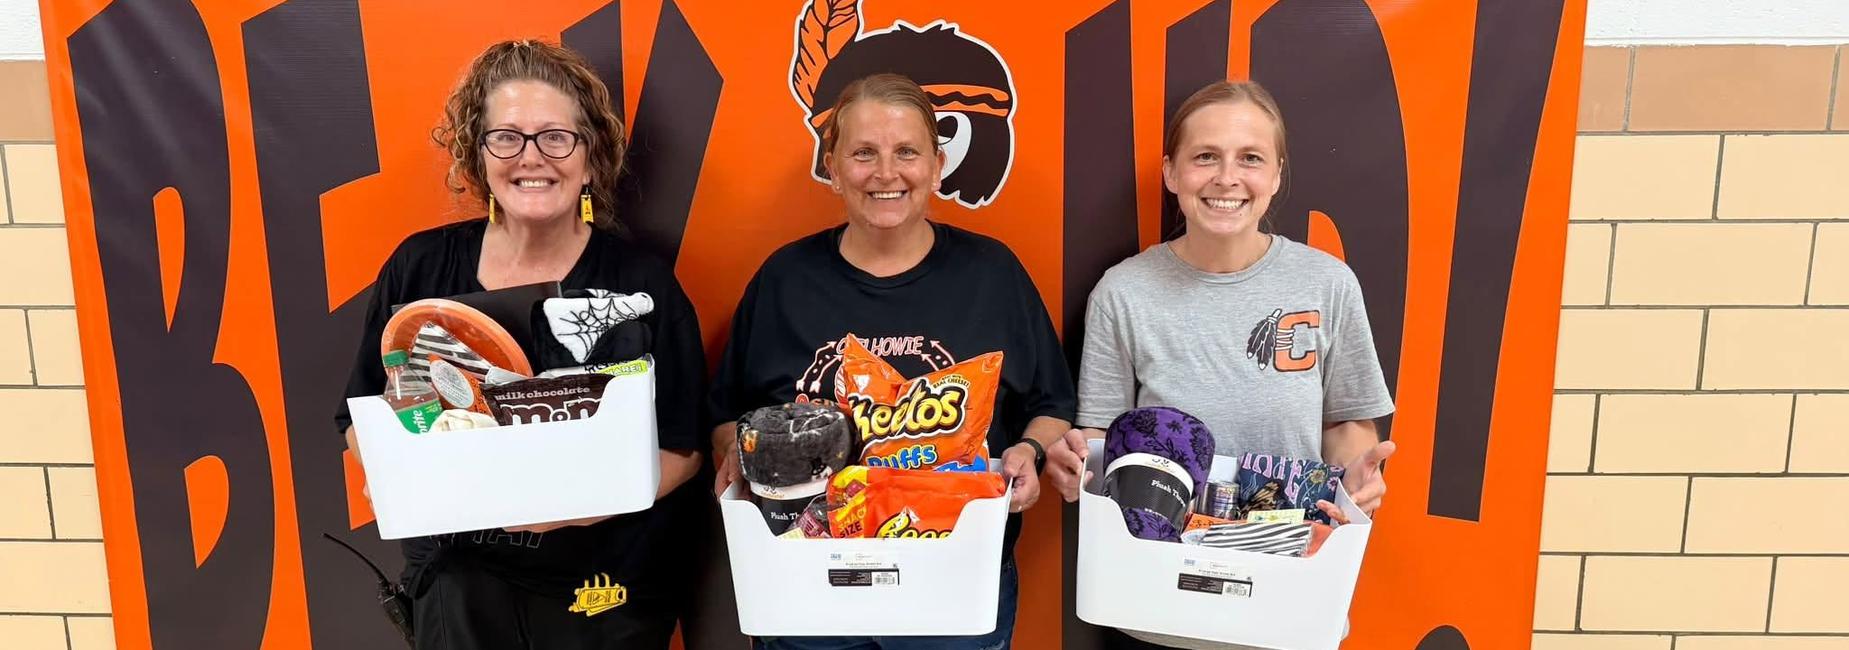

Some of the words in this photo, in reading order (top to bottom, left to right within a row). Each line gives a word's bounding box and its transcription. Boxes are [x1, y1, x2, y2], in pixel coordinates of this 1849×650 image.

[1273, 310, 1320, 372] C
[494, 391, 526, 401] milk
[526, 386, 591, 399] chocolate
[848, 378, 965, 441] heetos
[1151, 479, 1172, 494] Plush
[770, 511, 789, 520] Plush
[839, 520, 864, 539] SIZE
